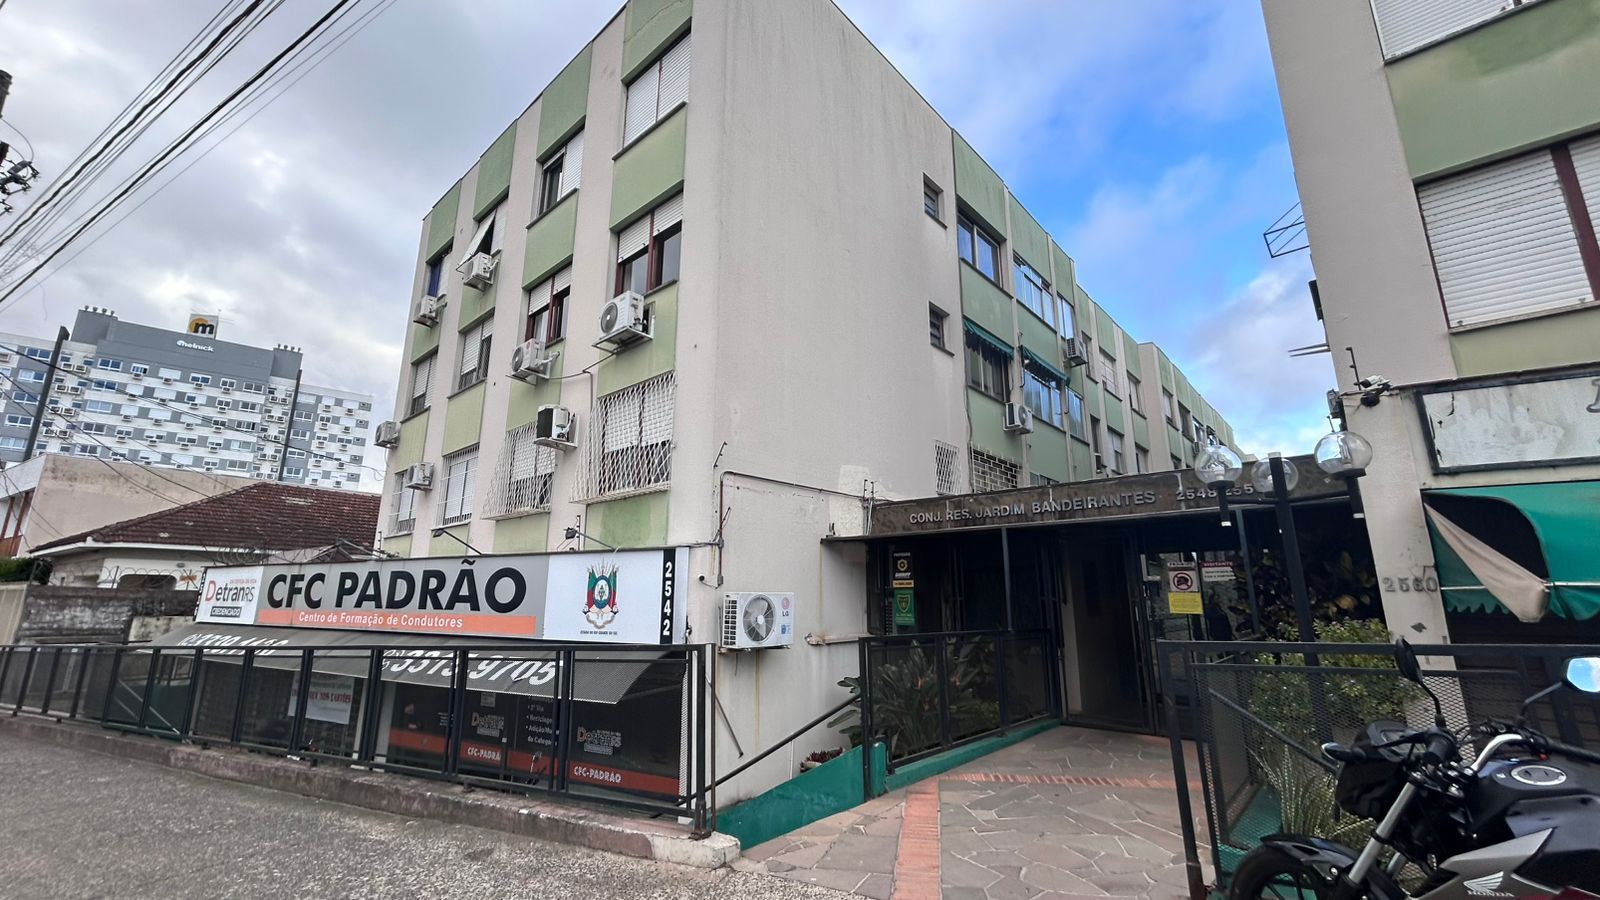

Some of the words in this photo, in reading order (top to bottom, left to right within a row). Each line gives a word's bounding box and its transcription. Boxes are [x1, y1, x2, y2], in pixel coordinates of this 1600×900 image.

[909, 512, 942, 524] CONJ.
[946, 508, 972, 520] RES.
[975, 504, 1025, 518] JARDIM
[1032, 490, 1156, 514] BANDEIRANTES
[1176, 487, 1217, 500] 2548
[267, 573, 326, 609] CFC
[335, 558, 527, 614] PADRÃO
[663, 561, 673, 636] 2542
[299, 611, 326, 624] Centro
[327, 612, 338, 623] de
[340, 612, 384, 627] Formação
[386, 614, 399, 625] de
[401, 614, 464, 628] Condutores
[1467, 890, 1515, 898] HONDA
